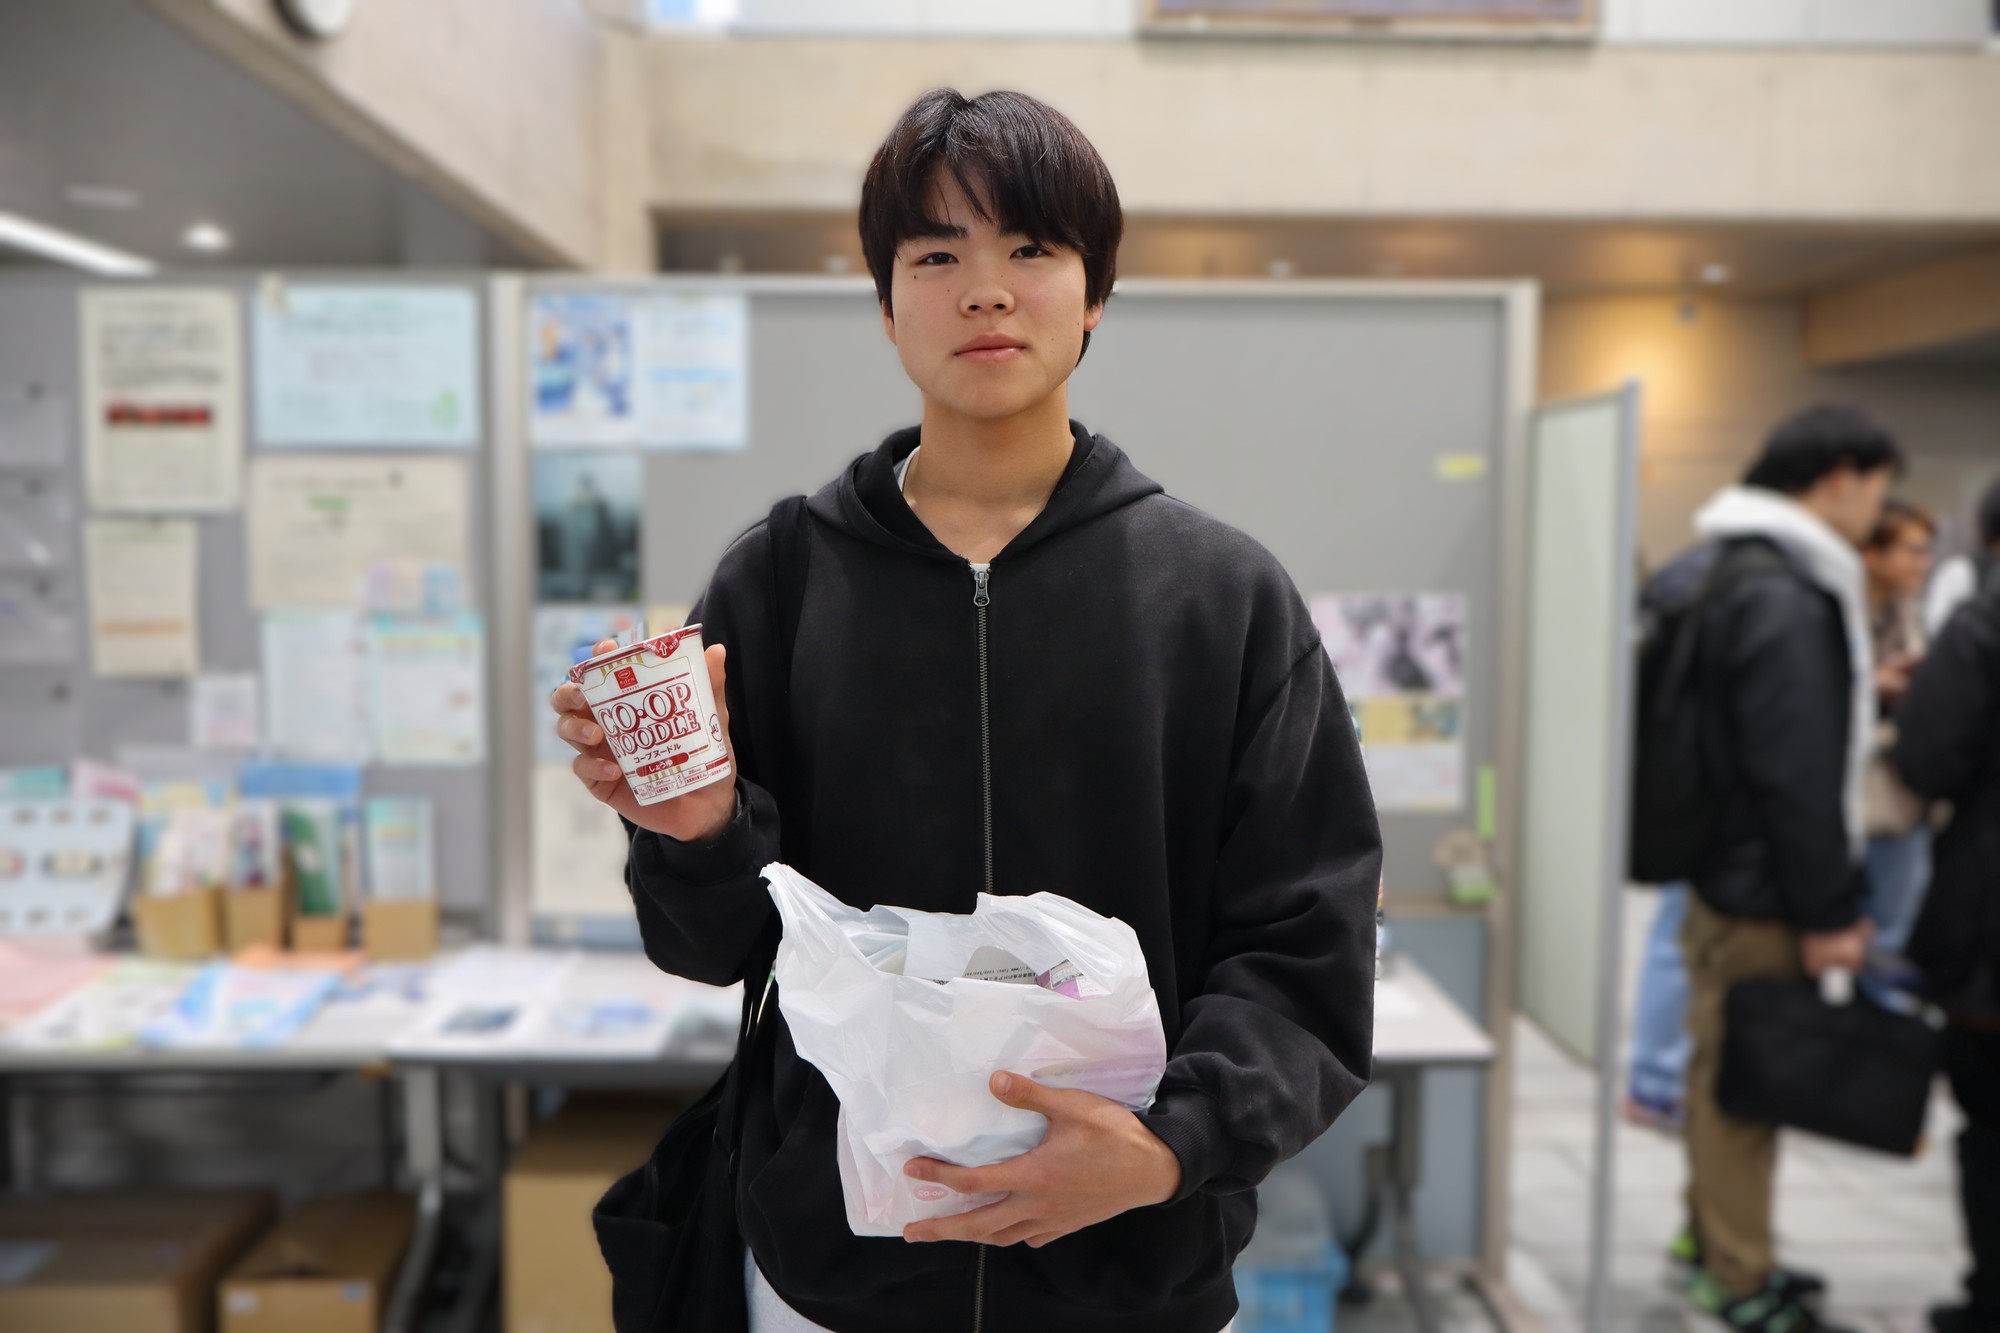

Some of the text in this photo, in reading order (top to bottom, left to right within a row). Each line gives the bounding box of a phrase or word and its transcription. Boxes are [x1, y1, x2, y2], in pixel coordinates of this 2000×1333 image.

[608, 710, 702, 758] NOODLE
[634, 743, 681, 764] コープヌードル
[648, 759, 674, 772] しょうゆ
